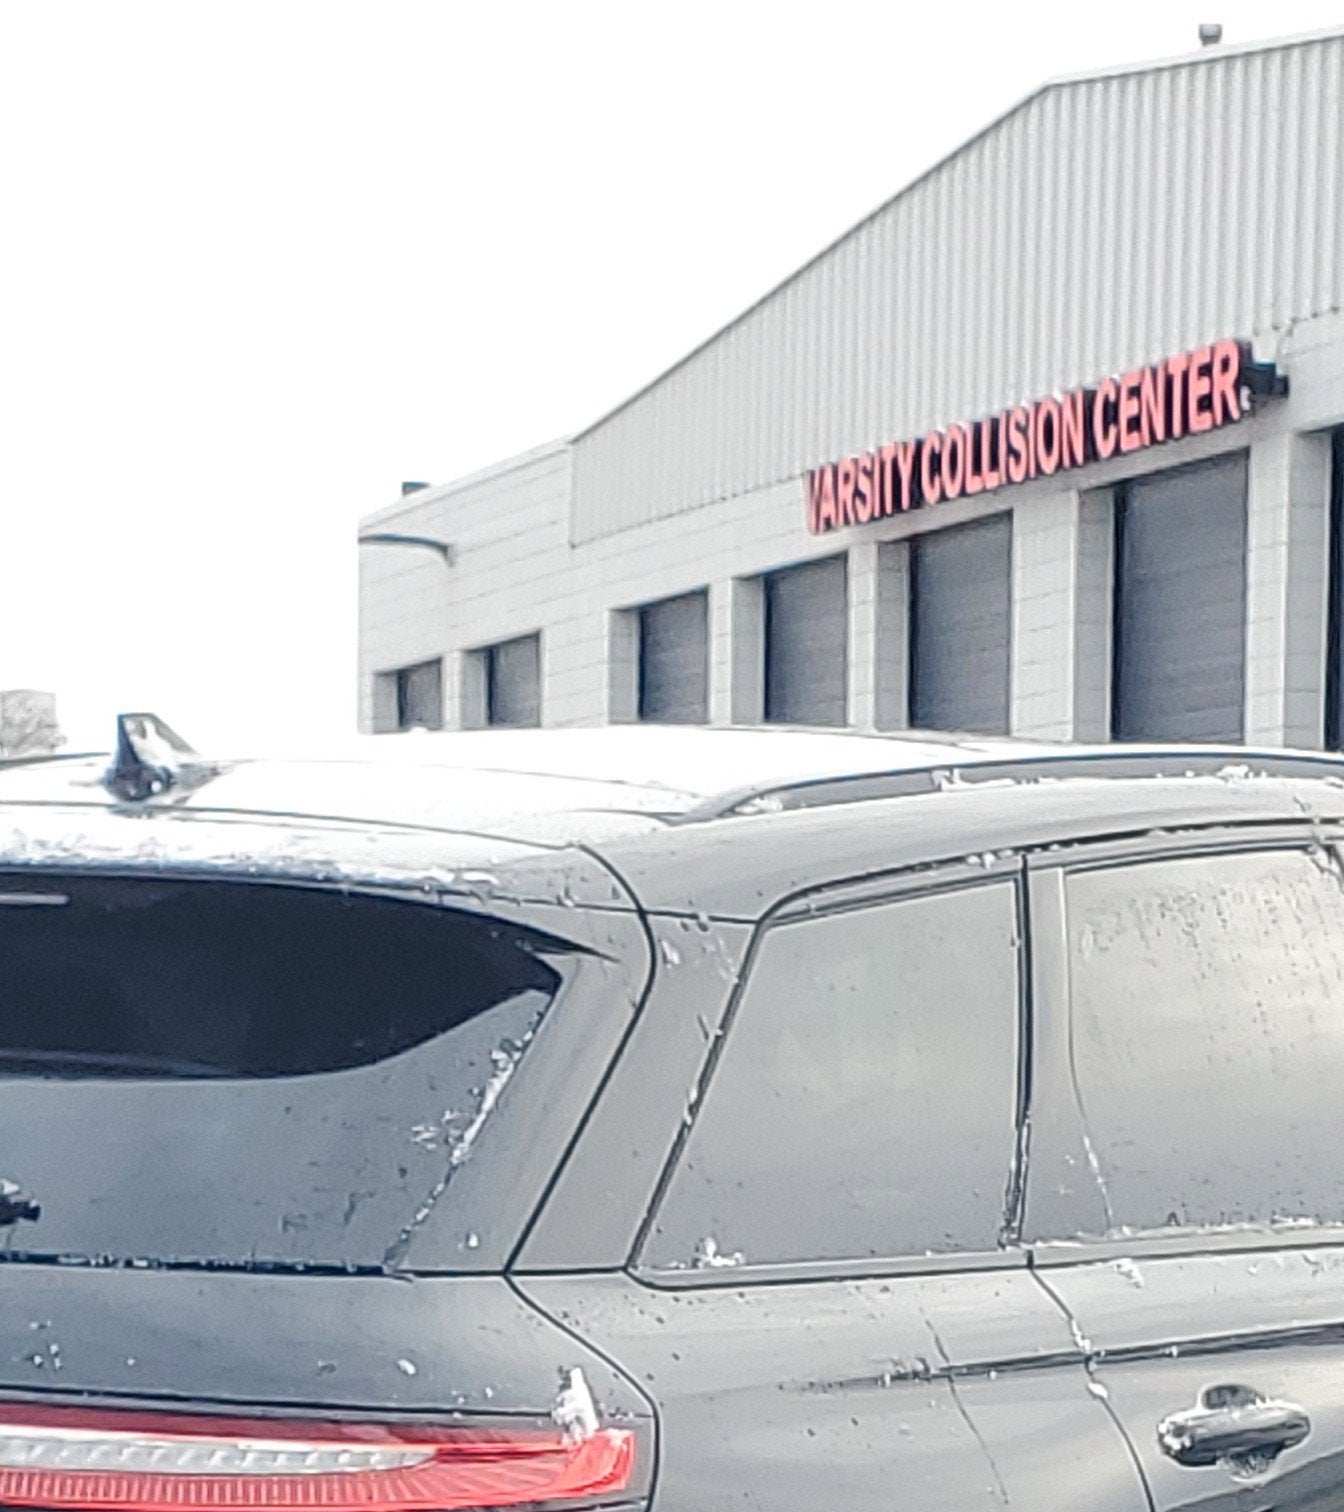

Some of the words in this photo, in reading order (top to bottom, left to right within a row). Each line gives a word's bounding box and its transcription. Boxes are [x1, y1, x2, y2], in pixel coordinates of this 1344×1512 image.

[806, 442, 916, 535] VARSITY
[920, 387, 1085, 505] COLLISION
[1092, 337, 1242, 460] CENTER
